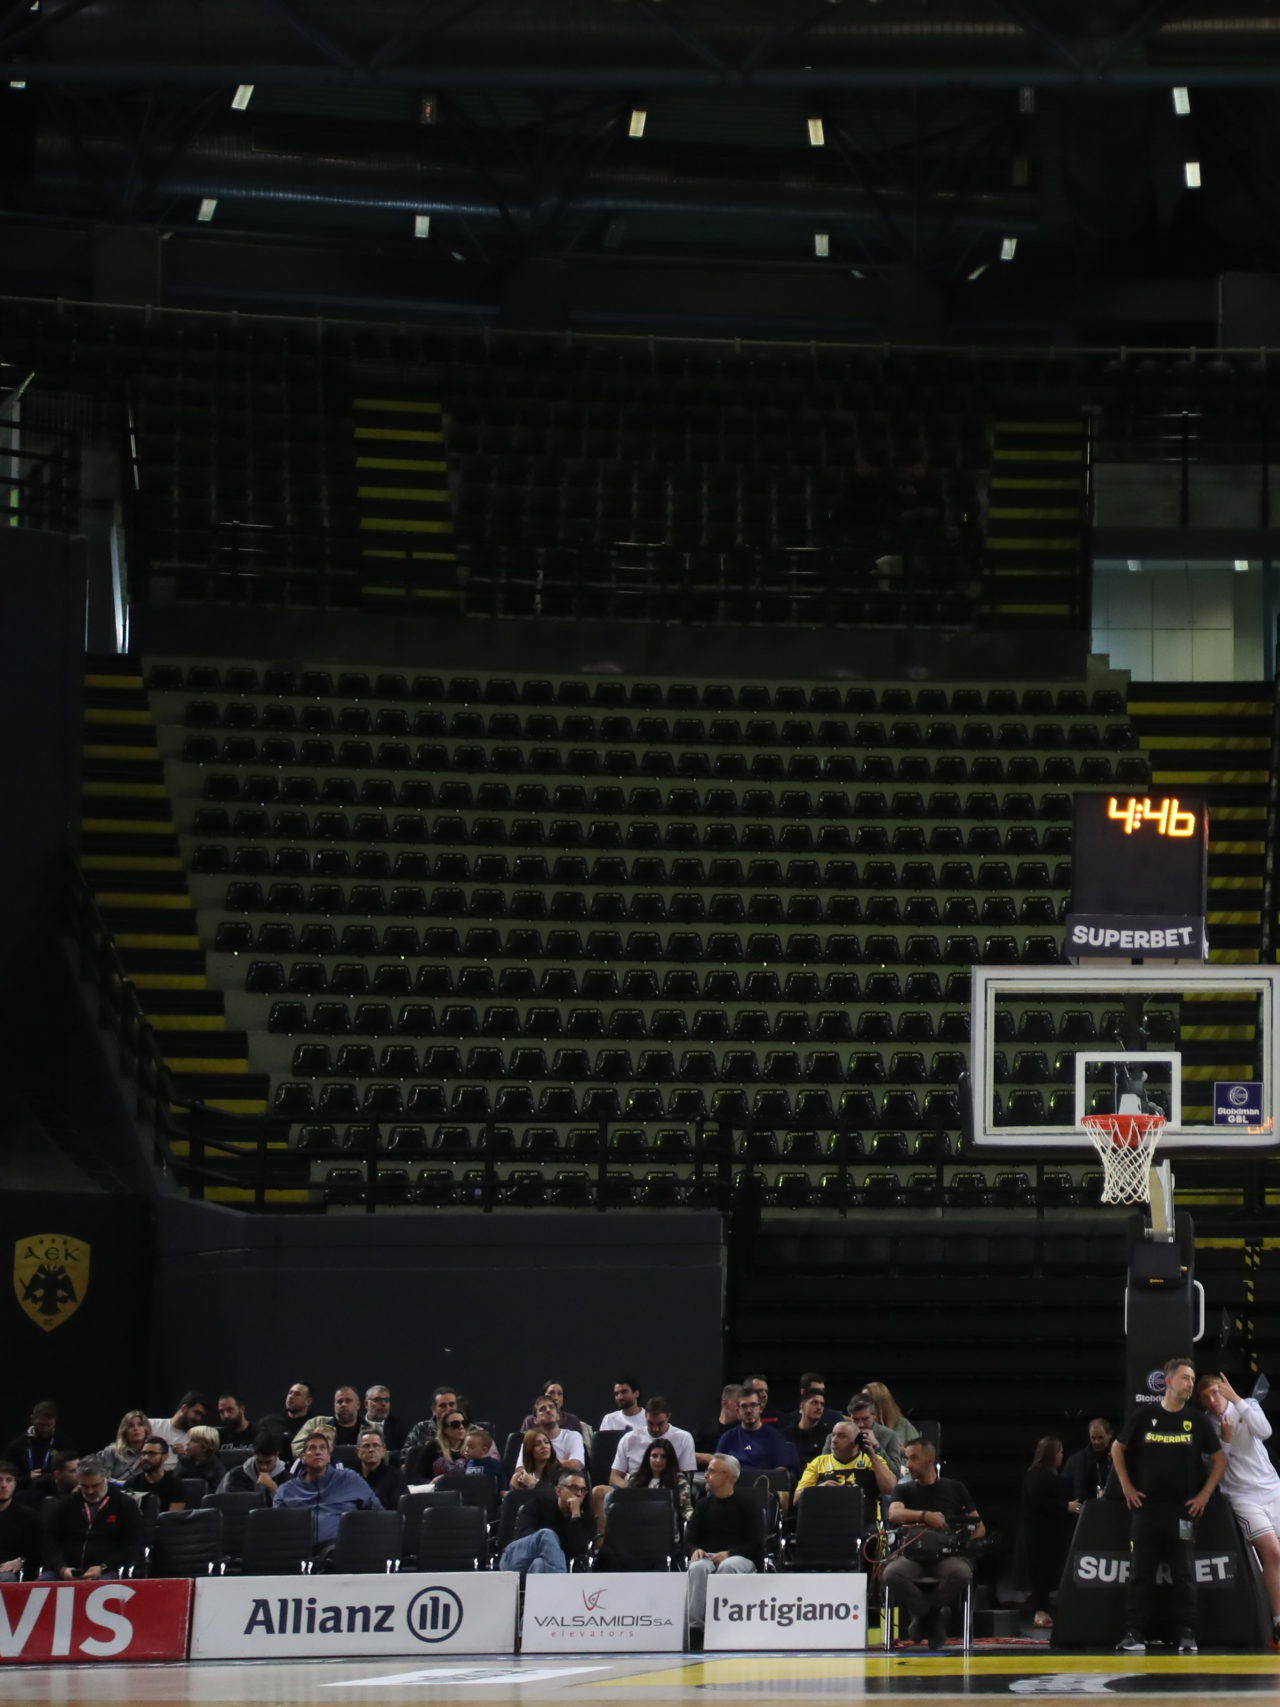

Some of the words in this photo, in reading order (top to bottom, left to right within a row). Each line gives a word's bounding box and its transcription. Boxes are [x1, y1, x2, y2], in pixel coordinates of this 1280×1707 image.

[1107, 796, 1197, 838] 4:46
[1072, 924, 1193, 949] SUPERBET
[1228, 1115, 1249, 1124] GBL
[1145, 1432, 1192, 1444] SUPERBET
[835, 1472, 857, 1486] 34
[1077, 1555, 1230, 1585] SUPRET
[243, 1597, 395, 1635] Allianz
[551, 1629, 634, 1638] elevators
